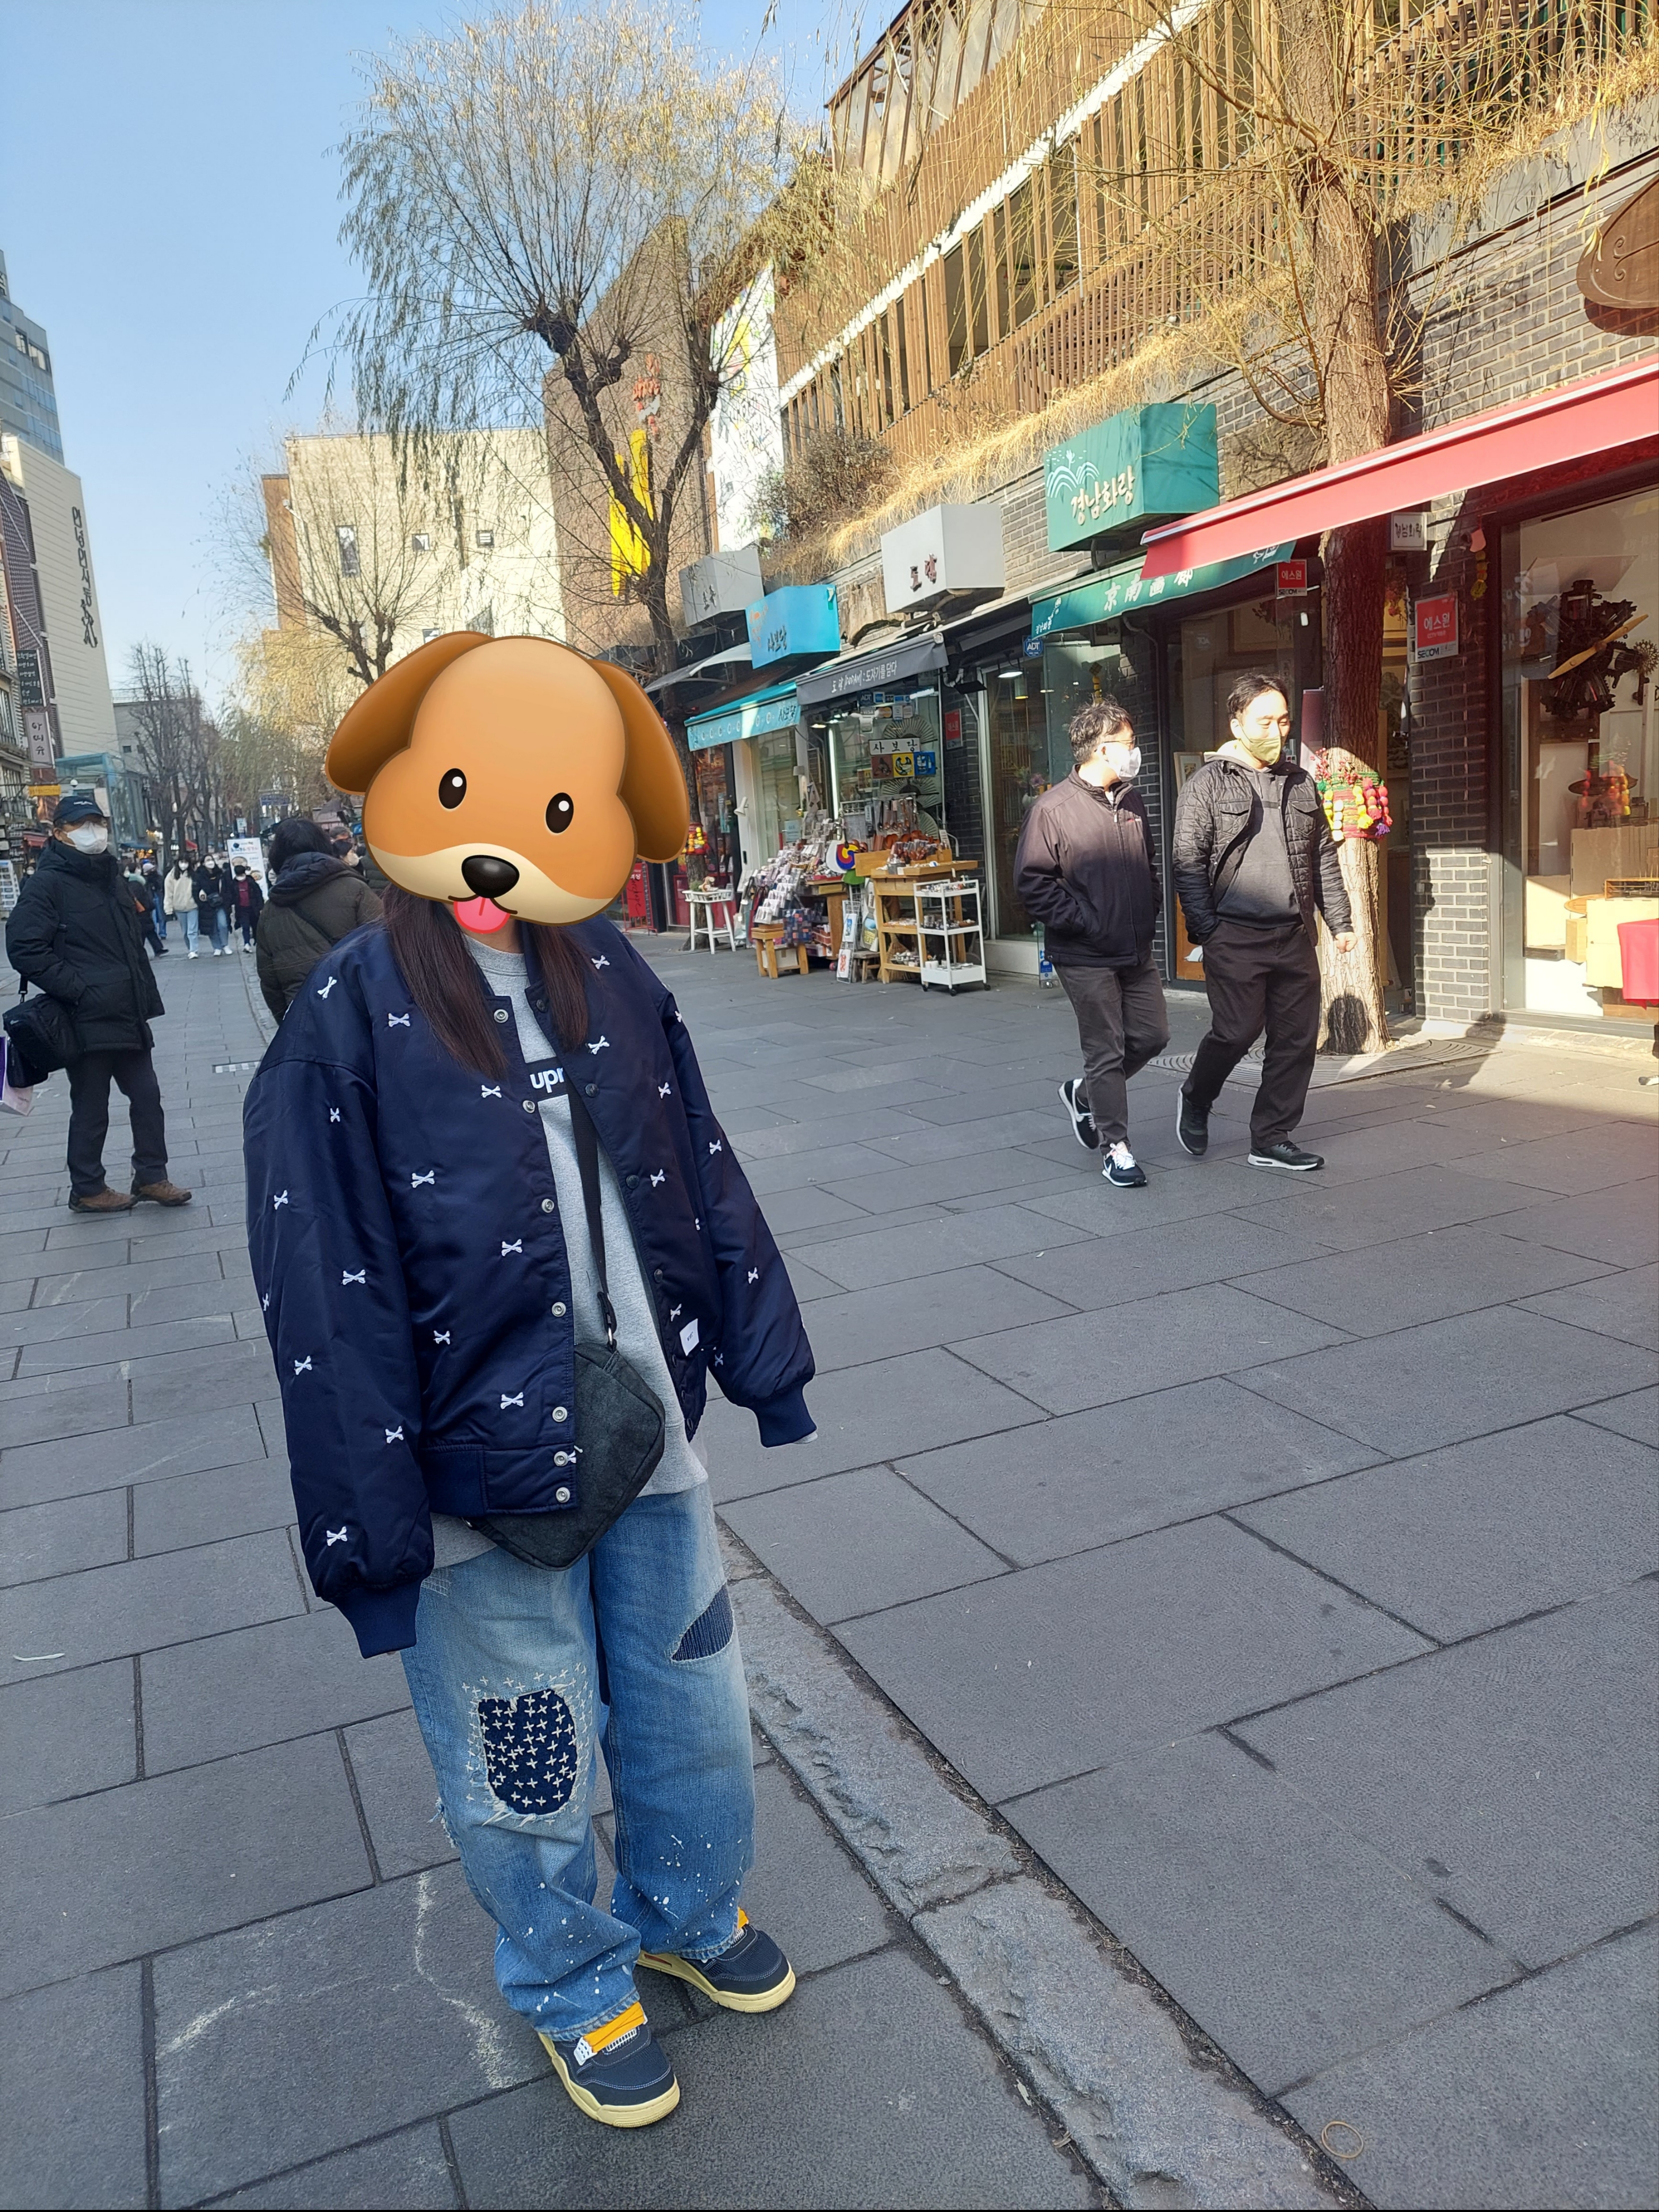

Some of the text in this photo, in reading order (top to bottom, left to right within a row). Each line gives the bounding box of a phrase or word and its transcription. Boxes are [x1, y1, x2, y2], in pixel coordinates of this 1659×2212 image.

[1070, 464, 1136, 525] 경남화랑
[1394, 522, 1423, 539] 경남화랑
[1281, 569, 1302, 580] 에스원
[1424, 612, 1451, 631] 에스원
[1027, 642, 1040, 651] ADT
[1417, 647, 1440, 659] SECOM
[886, 660, 897, 678] 담다
[873, 739, 918, 753] 사보당
